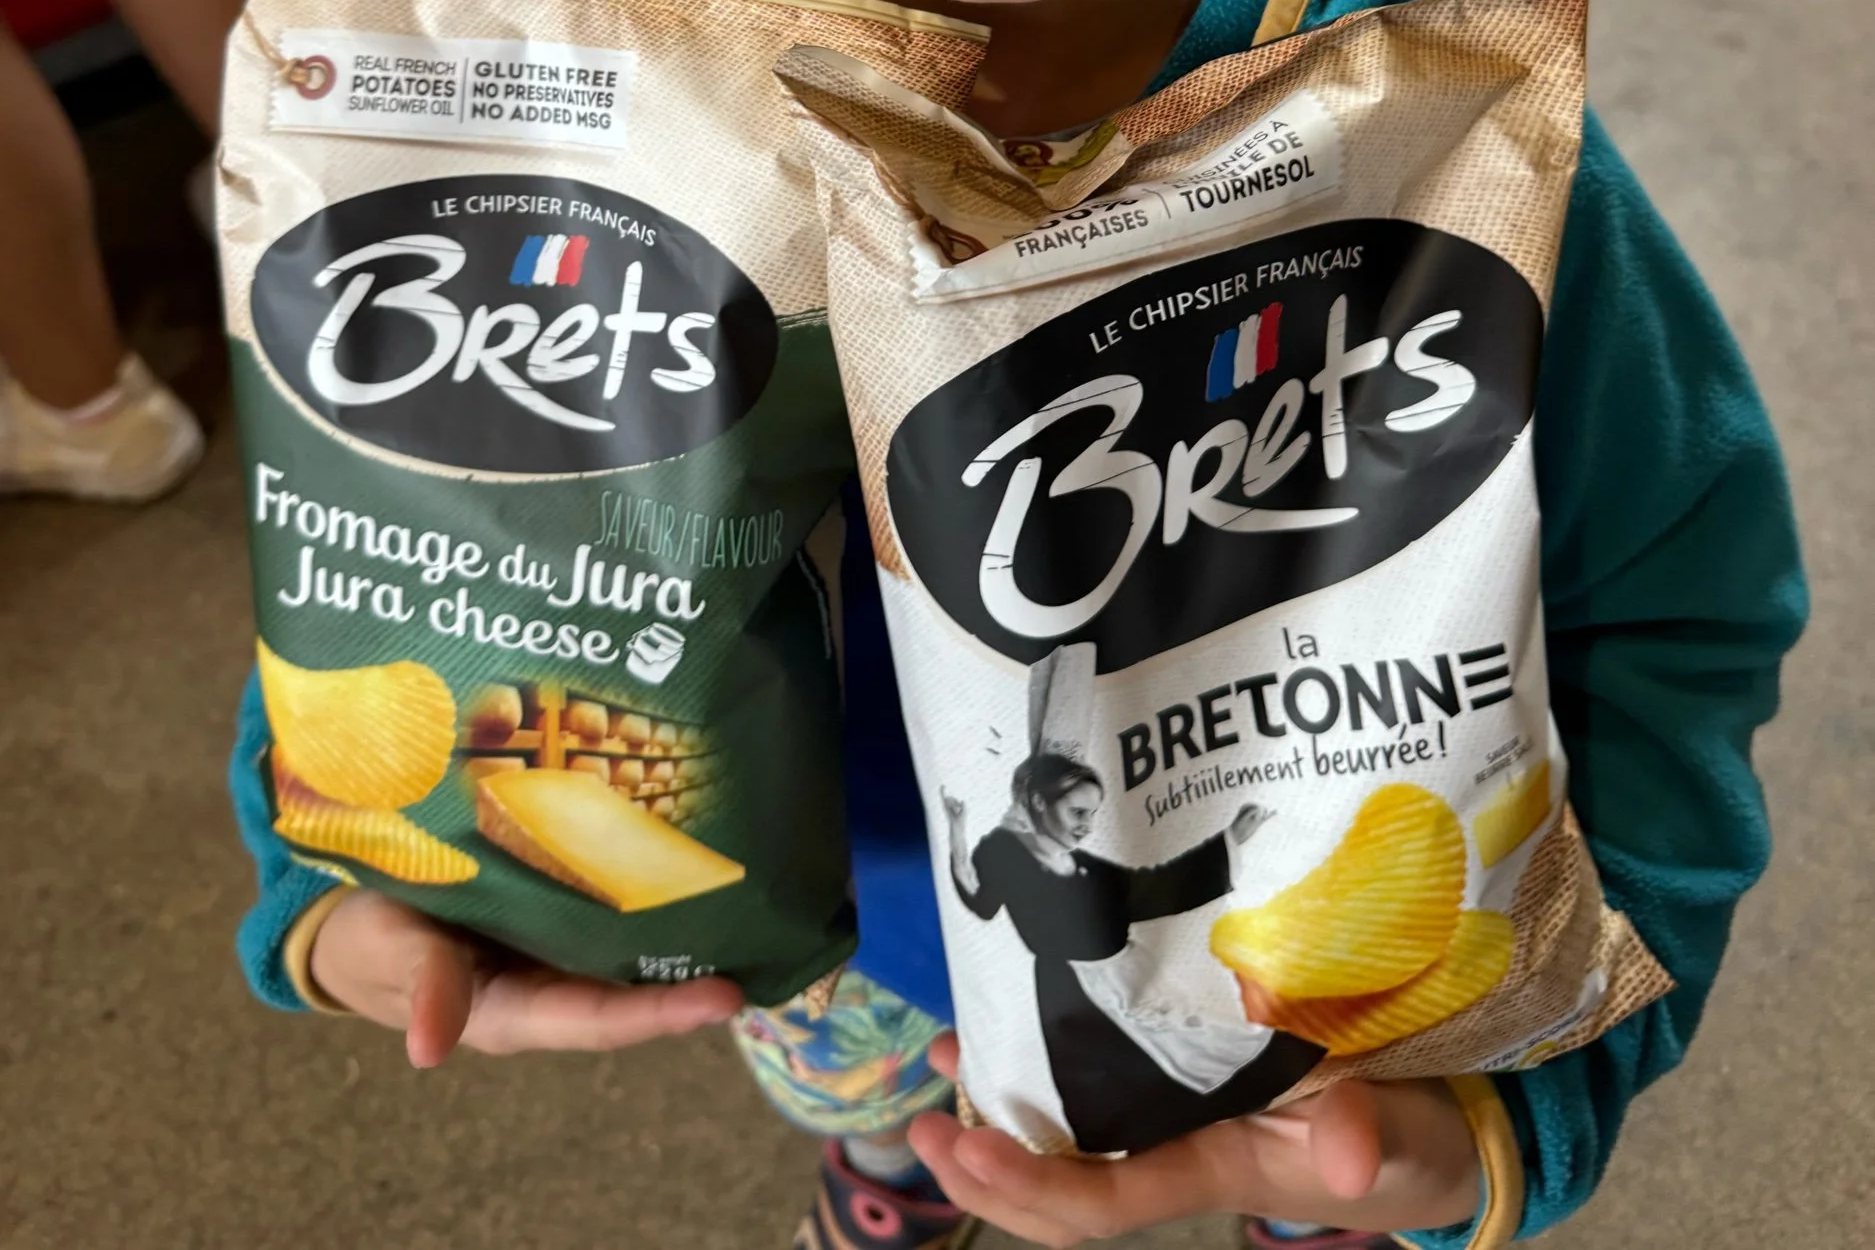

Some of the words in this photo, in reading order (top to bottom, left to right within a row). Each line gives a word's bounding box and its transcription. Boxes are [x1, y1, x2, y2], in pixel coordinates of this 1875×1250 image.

[354, 54, 391, 72] REAL
[395, 58, 457, 75] FRENCH
[474, 60, 561, 83] GLUTEN
[565, 67, 618, 88] FREE
[351, 74, 456, 98] POTATOES
[472, 81, 499, 99] NO
[503, 84, 614, 109] PRESERVATIVES
[348, 95, 429, 114] SUNFLOWER
[430, 100, 455, 116] OIL
[470, 103, 504, 120] NO
[509, 105, 573, 126] ADDED
[575, 111, 612, 130] MSG
[1267, 131, 1305, 154] DE
[1179, 154, 1316, 213] TOURNESOL
[431, 198, 459, 219] LE
[464, 194, 562, 216] CHIPSIER
[568, 200, 658, 248] FRANÇAIS
[1014, 208, 1150, 257] FRANÇAISES
[1088, 320, 1123, 354] LE
[1128, 272, 1250, 331] CHIPSIER
[1255, 245, 1365, 289] FRANÇAIS
[254, 461, 490, 585] Fromage
[498, 543, 558, 592] du
[547, 543, 707, 621] Jura
[277, 545, 416, 623] Jura
[428, 586, 622, 664] cheese
[1281, 626, 1320, 661] la
[1117, 641, 1515, 793] BRETONNE
